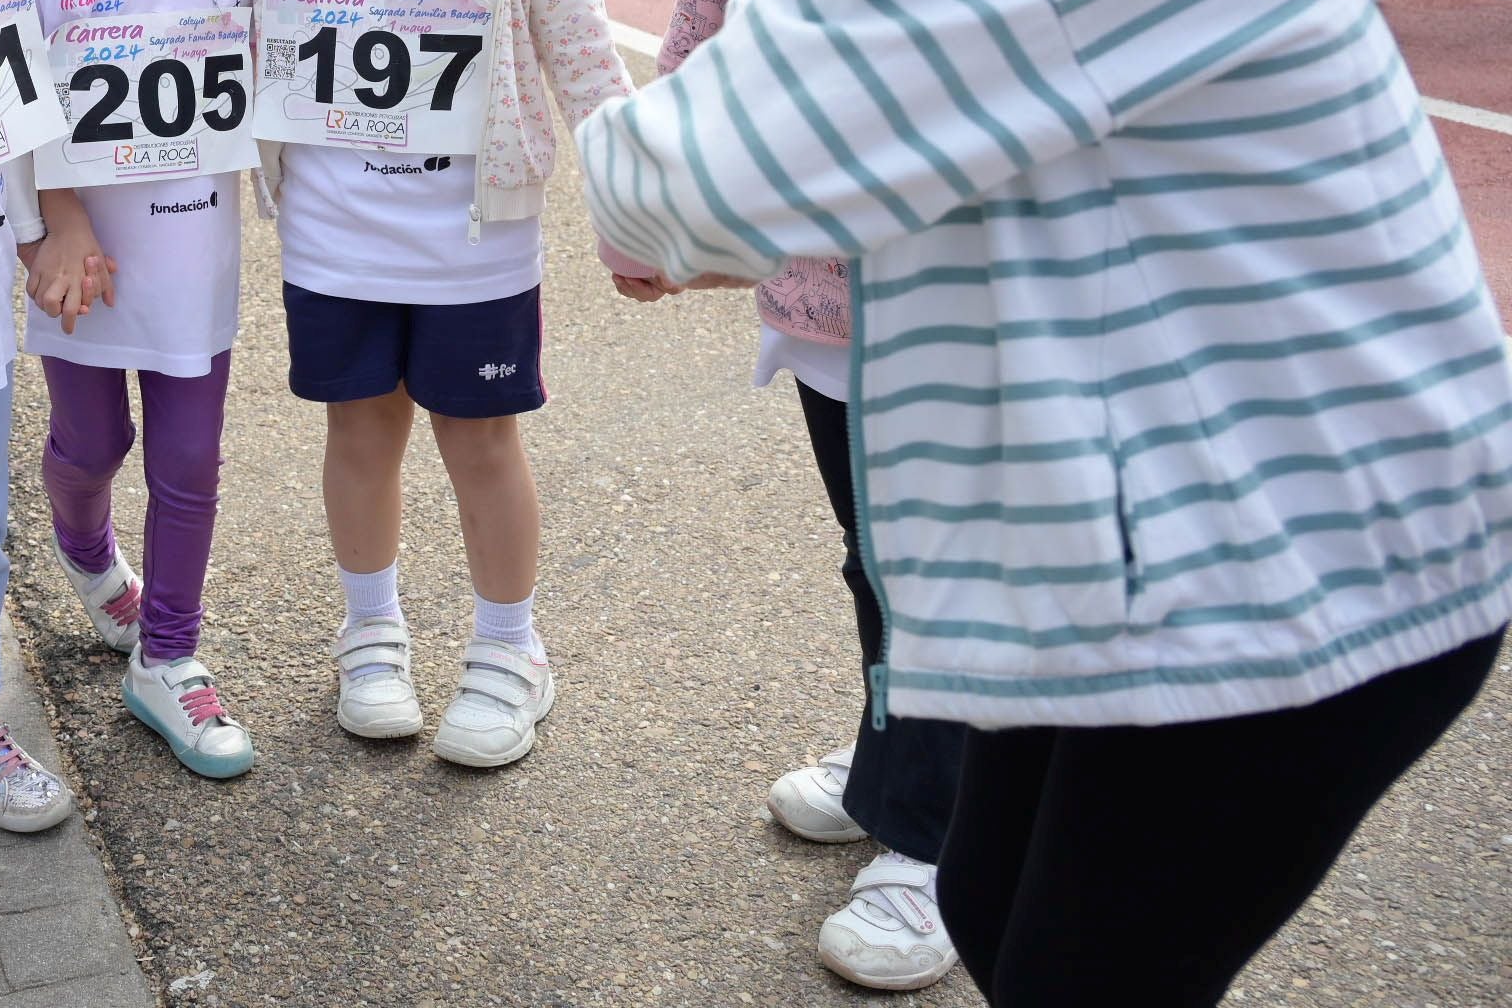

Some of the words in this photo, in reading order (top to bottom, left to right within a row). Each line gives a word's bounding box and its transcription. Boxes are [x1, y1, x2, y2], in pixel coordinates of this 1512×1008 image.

[179, 16, 205, 28] Colegio
[311, 9, 363, 28] 2024
[368, 6, 405, 22] Sagrada
[409, 7, 446, 18] Familia
[450, 10, 492, 25] Badajoz
[65, 24, 144, 43] Carrera
[149, 36, 185, 50] Sagrada
[188, 32, 216, 41] Familia
[218, 30, 248, 43] Badajoz
[83, 44, 145, 63] 2024
[181, 48, 207, 61] mayo
[299, 26, 483, 111] 197
[69, 54, 247, 144] 205
[344, 118, 360, 130] LA
[366, 120, 405, 134] ROCA
[134, 151, 151, 163] LA
[158, 147, 197, 162] ROCA
[150, 199, 210, 215] fundación
